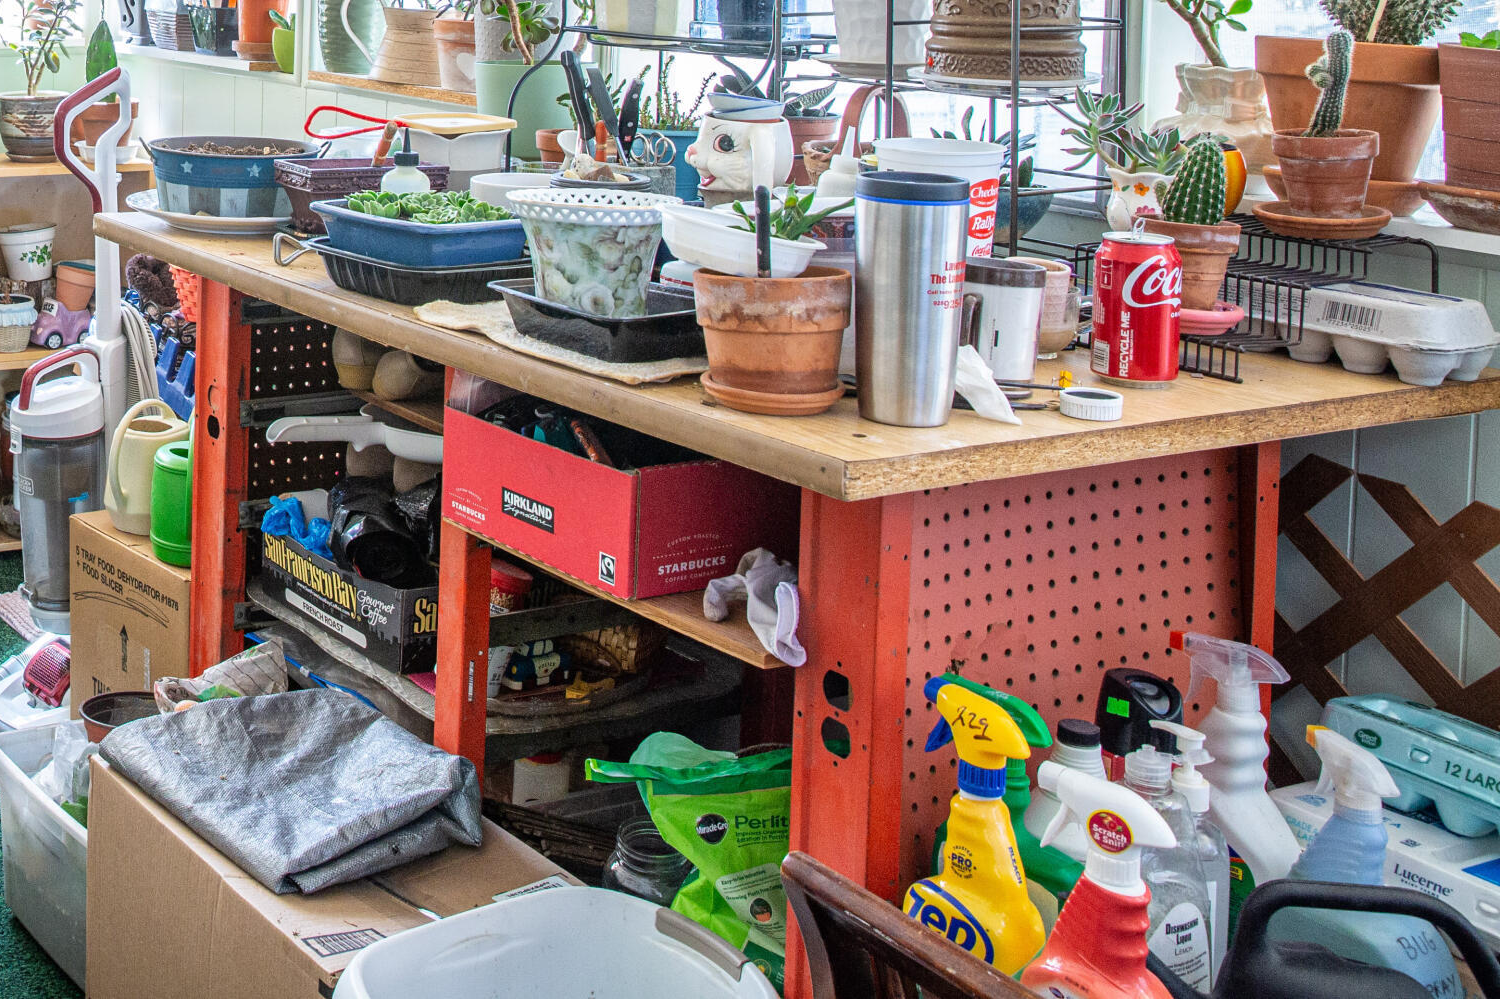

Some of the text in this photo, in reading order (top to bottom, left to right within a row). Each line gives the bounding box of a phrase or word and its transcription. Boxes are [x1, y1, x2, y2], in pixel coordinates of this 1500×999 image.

[930, 274, 947, 284] The
[1119, 311, 1131, 377] RECYCLE ME
[452, 500, 486, 521] STARBUCKS
[503, 490, 553, 521] KIRKLAND
[81, 547, 96, 564] TRAY
[97, 557, 115, 576] FOOD
[117, 568, 161, 602] DEHYDRATOR
[657, 555, 727, 576] STARBUCKS
[82, 562, 99, 581] FOOD
[100, 572, 124, 596] SLICER
[356, 589, 396, 615] Gourmet
[302, 601, 344, 633] FRENCH ROAST
[361, 604, 388, 626] Coffee
[1444, 760, 1462, 778] 12
[734, 815, 789, 829] Perlit
[1092, 823, 1128, 843] Scratch
[951, 852, 973, 868] PRO
[1008, 846, 1023, 884] BLEACH
[1393, 863, 1451, 897] Lucerne
[1396, 929, 1437, 961] BUG
[1426, 973, 1457, 998] PRAY
